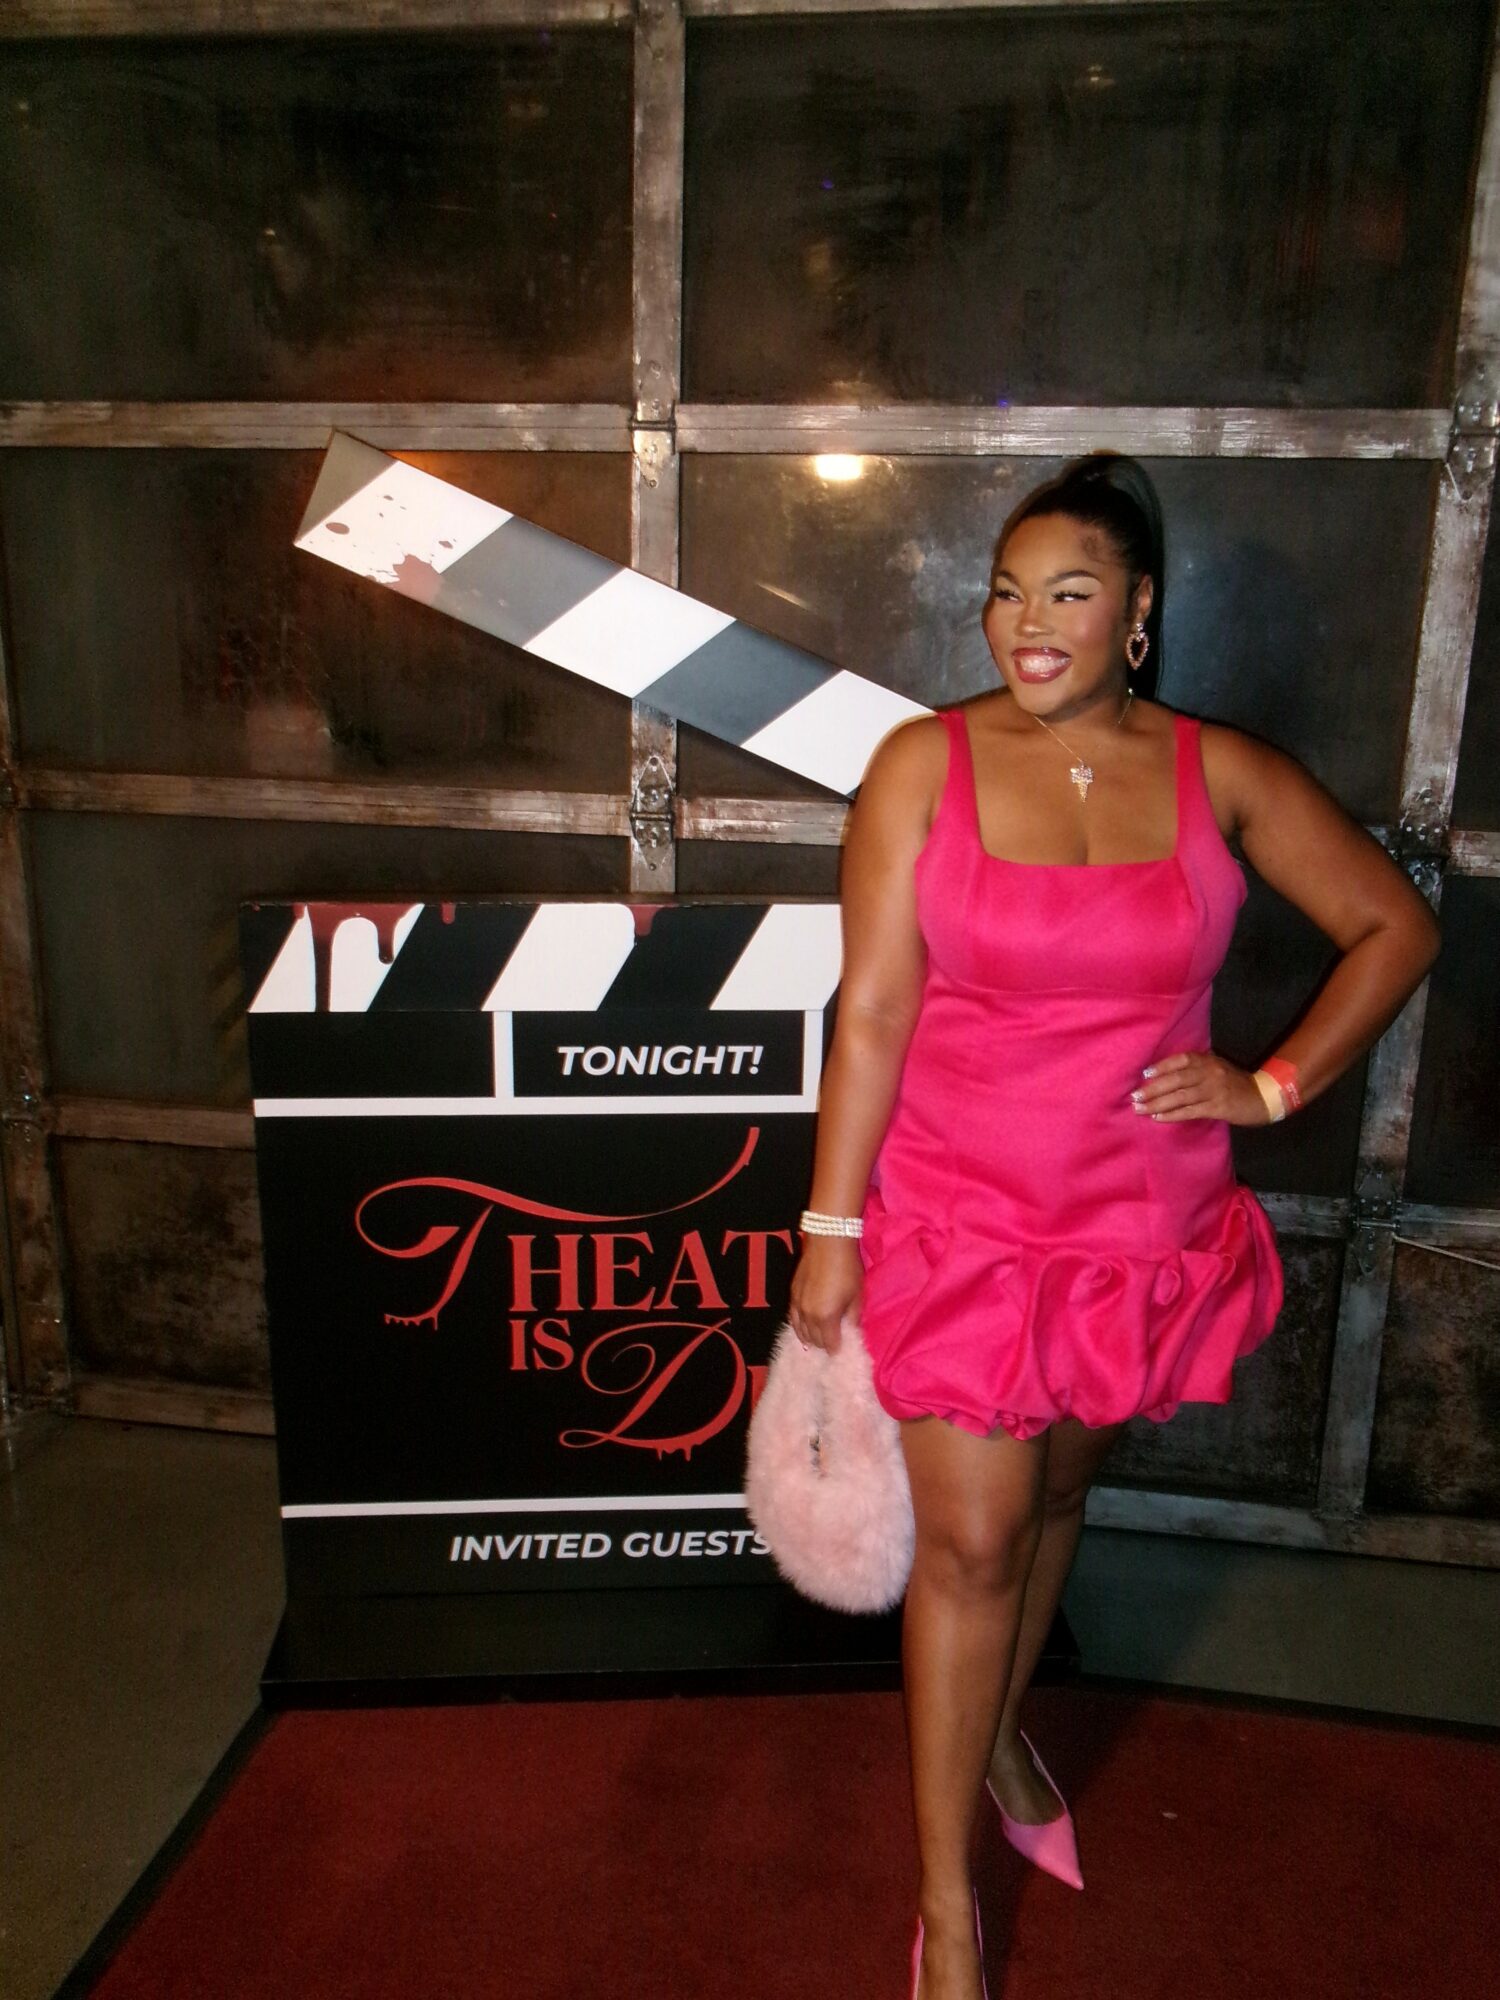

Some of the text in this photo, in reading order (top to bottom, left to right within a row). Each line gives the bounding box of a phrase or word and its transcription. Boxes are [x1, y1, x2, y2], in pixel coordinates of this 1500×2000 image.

[557, 1044, 764, 1076] TONIGHT!
[355, 1126, 806, 1331] THEAT
[509, 1318, 576, 1371] IS
[450, 1530, 773, 1562] INVITED GUESTS
